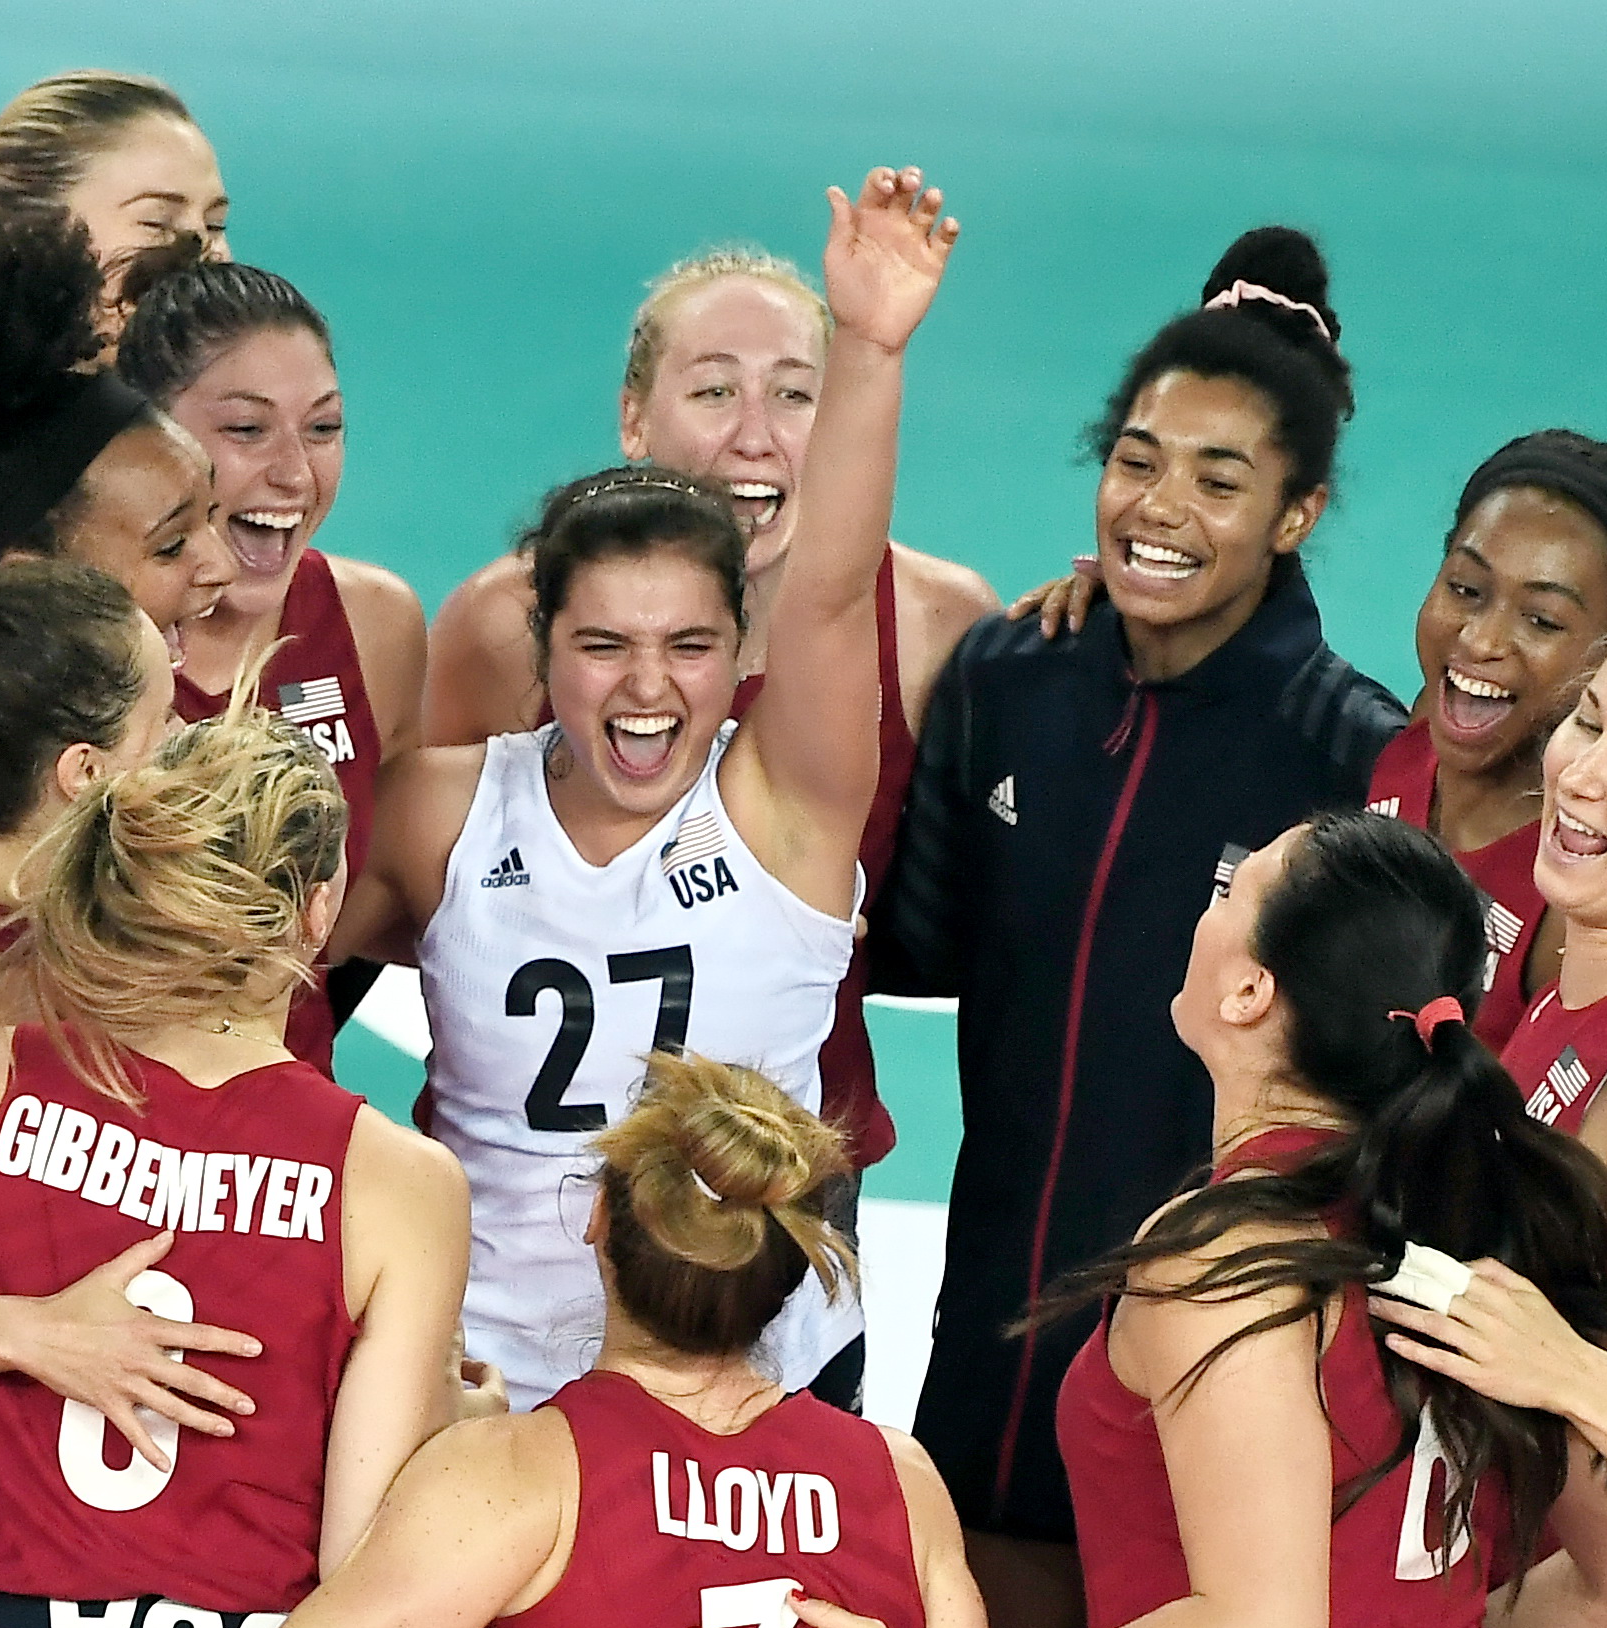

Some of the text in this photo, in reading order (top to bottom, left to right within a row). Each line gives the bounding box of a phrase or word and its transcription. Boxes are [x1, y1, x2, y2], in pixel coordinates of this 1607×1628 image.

[302, 718, 356, 765] SA
[480, 867, 531, 889] adidas
[671, 857, 740, 910] USA
[505, 944, 695, 1133] 27
[651, 1451, 842, 1555] LLOYD
